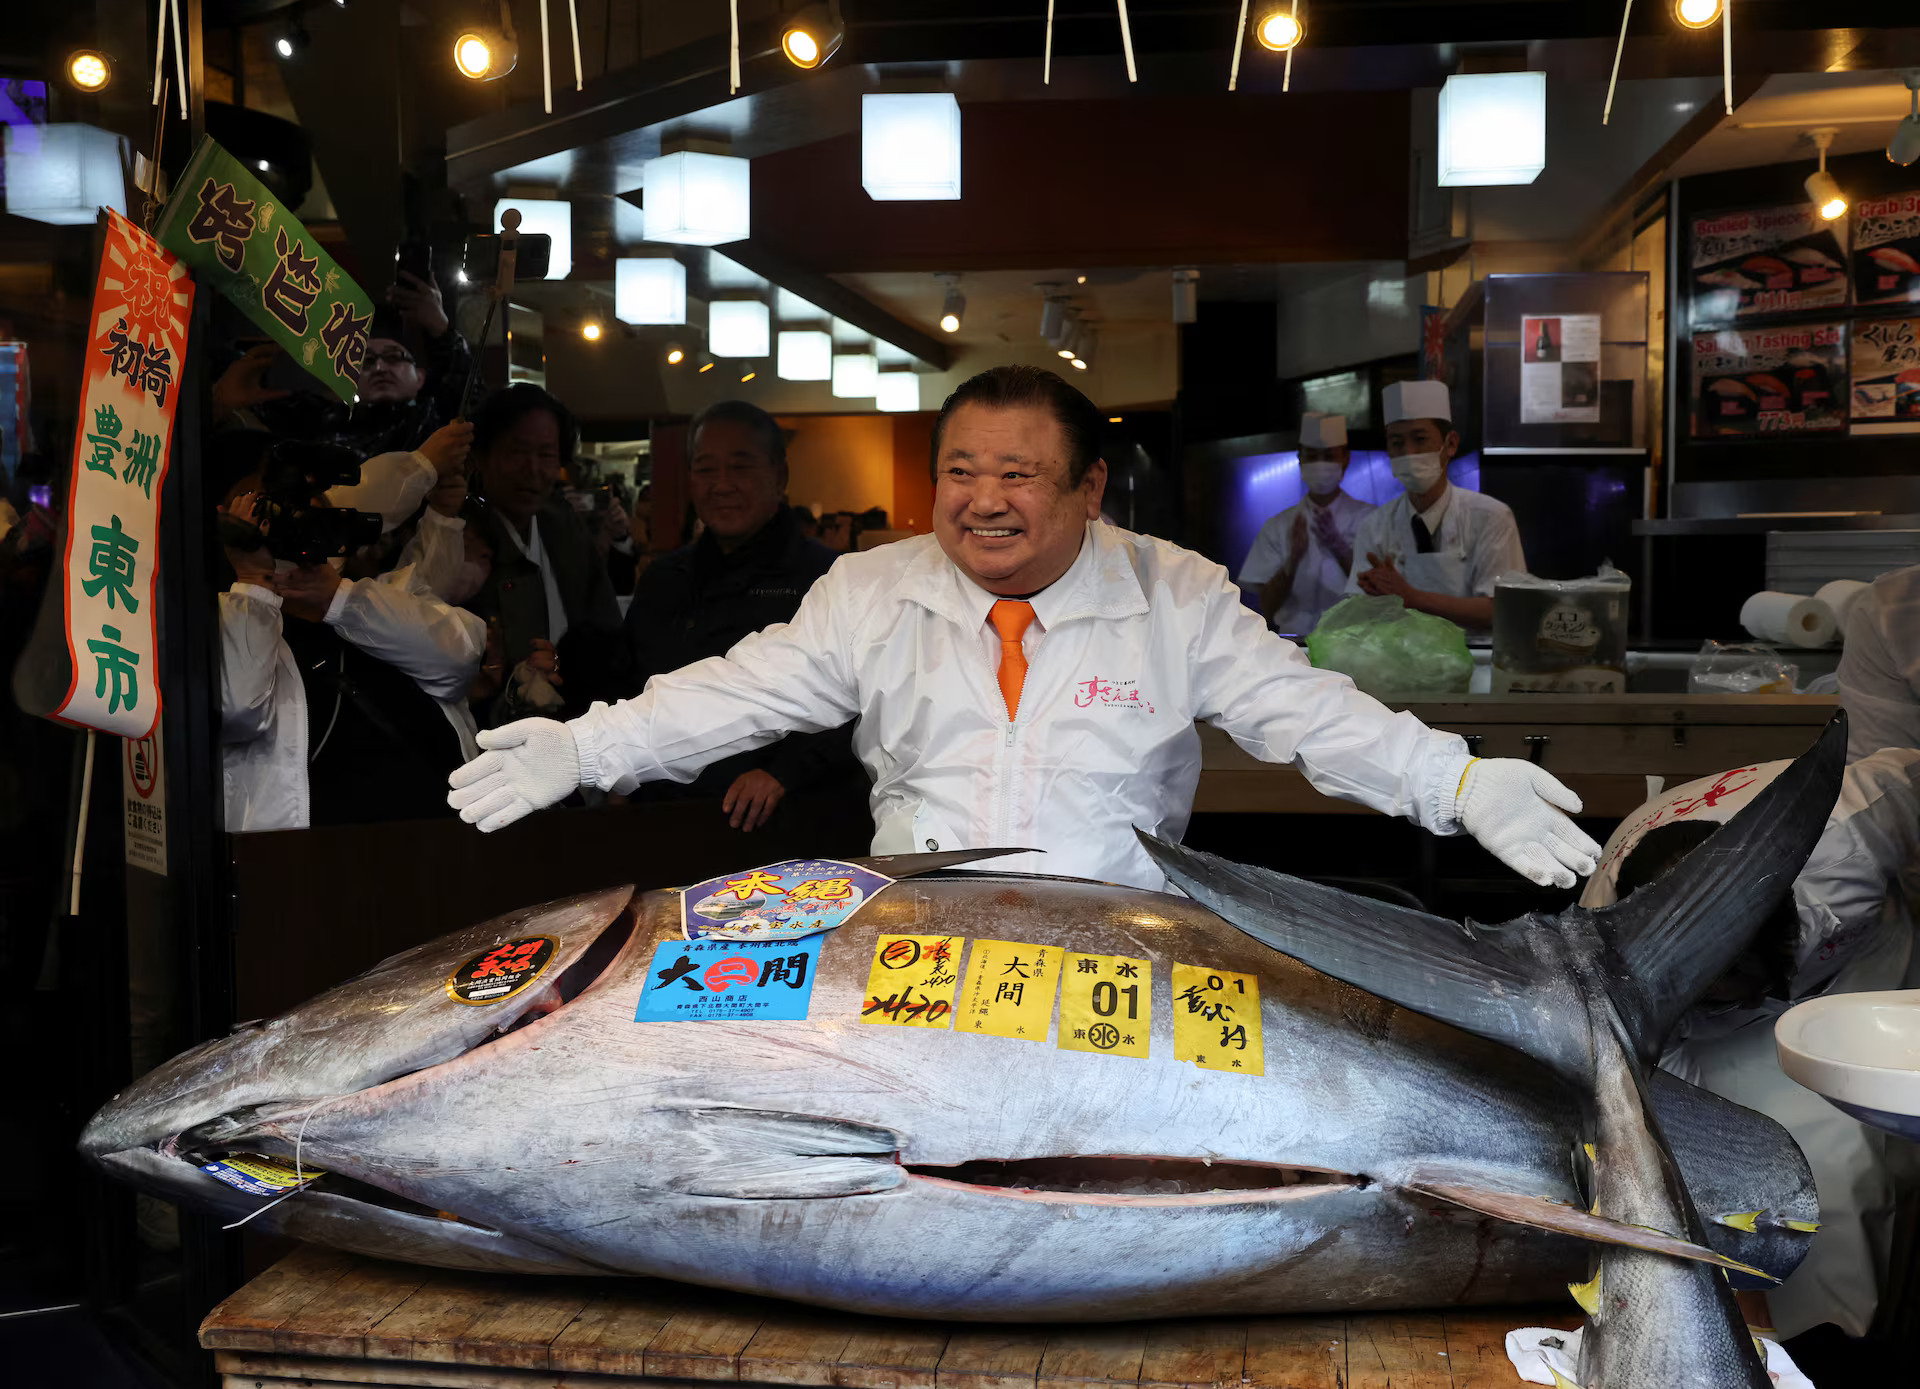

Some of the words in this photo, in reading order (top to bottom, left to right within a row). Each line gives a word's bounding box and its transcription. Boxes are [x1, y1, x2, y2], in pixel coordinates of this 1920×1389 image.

[1859, 200, 1898, 217] Crab
[121, 252, 172, 330] 祝
[1696, 337, 1749, 354] Saln
[1755, 331, 1811, 350] Tasting
[102, 318, 173, 408] 初荷
[85, 404, 161, 500] 豊洲
[1554, 612, 1578, 622] エコ
[683, 943, 731, 952] 青森県産
[1033, 949, 1048, 977] 青森県
[995, 956, 1030, 1006] 大間
[1207, 975, 1244, 994] 01
[698, 994, 748, 1003] 西山商店
[1092, 981, 1138, 1020] 01
